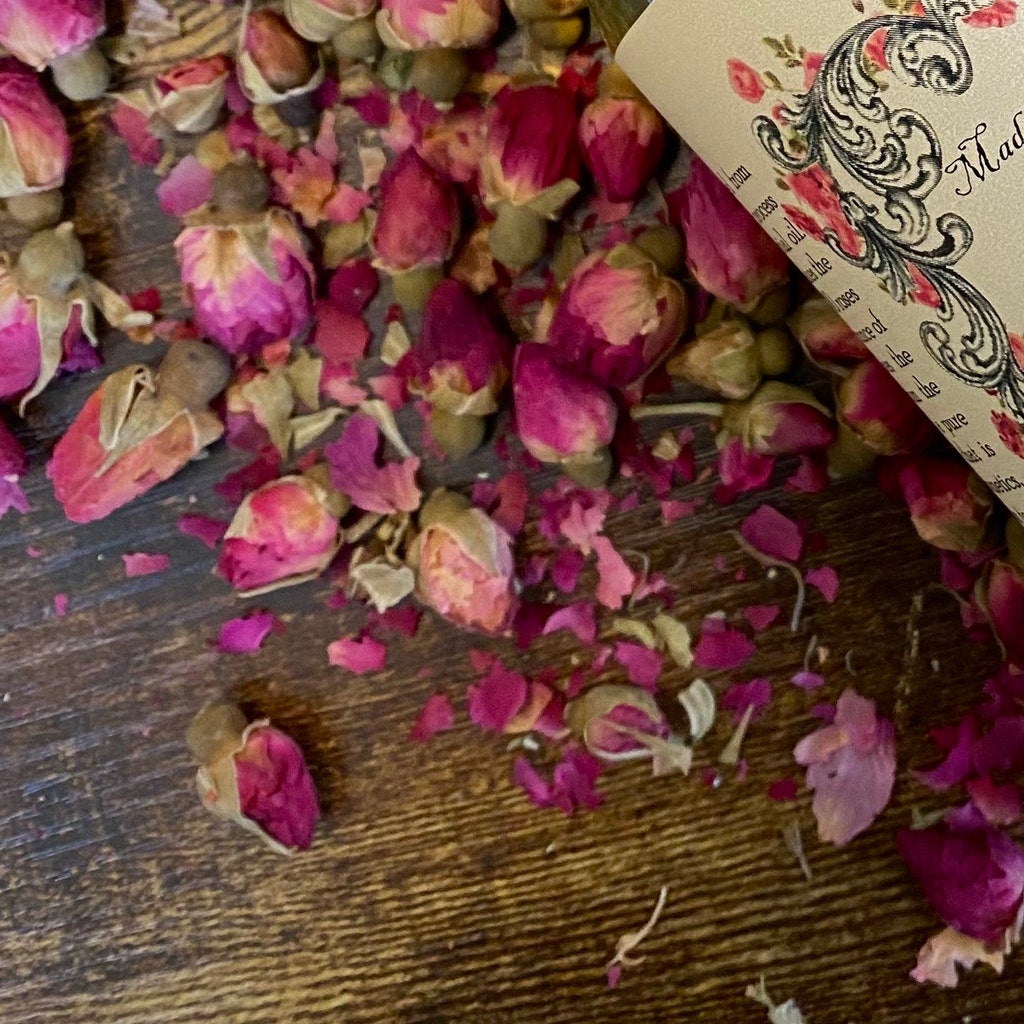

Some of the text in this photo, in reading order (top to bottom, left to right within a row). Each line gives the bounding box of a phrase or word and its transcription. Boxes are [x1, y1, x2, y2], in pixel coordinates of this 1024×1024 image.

[804, 252, 833, 282] the
[868, 308, 889, 335] of
[885, 343, 914, 370] the
[911, 374, 942, 400] the
[940, 410, 969, 438] pure
[978, 441, 997, 459] is
